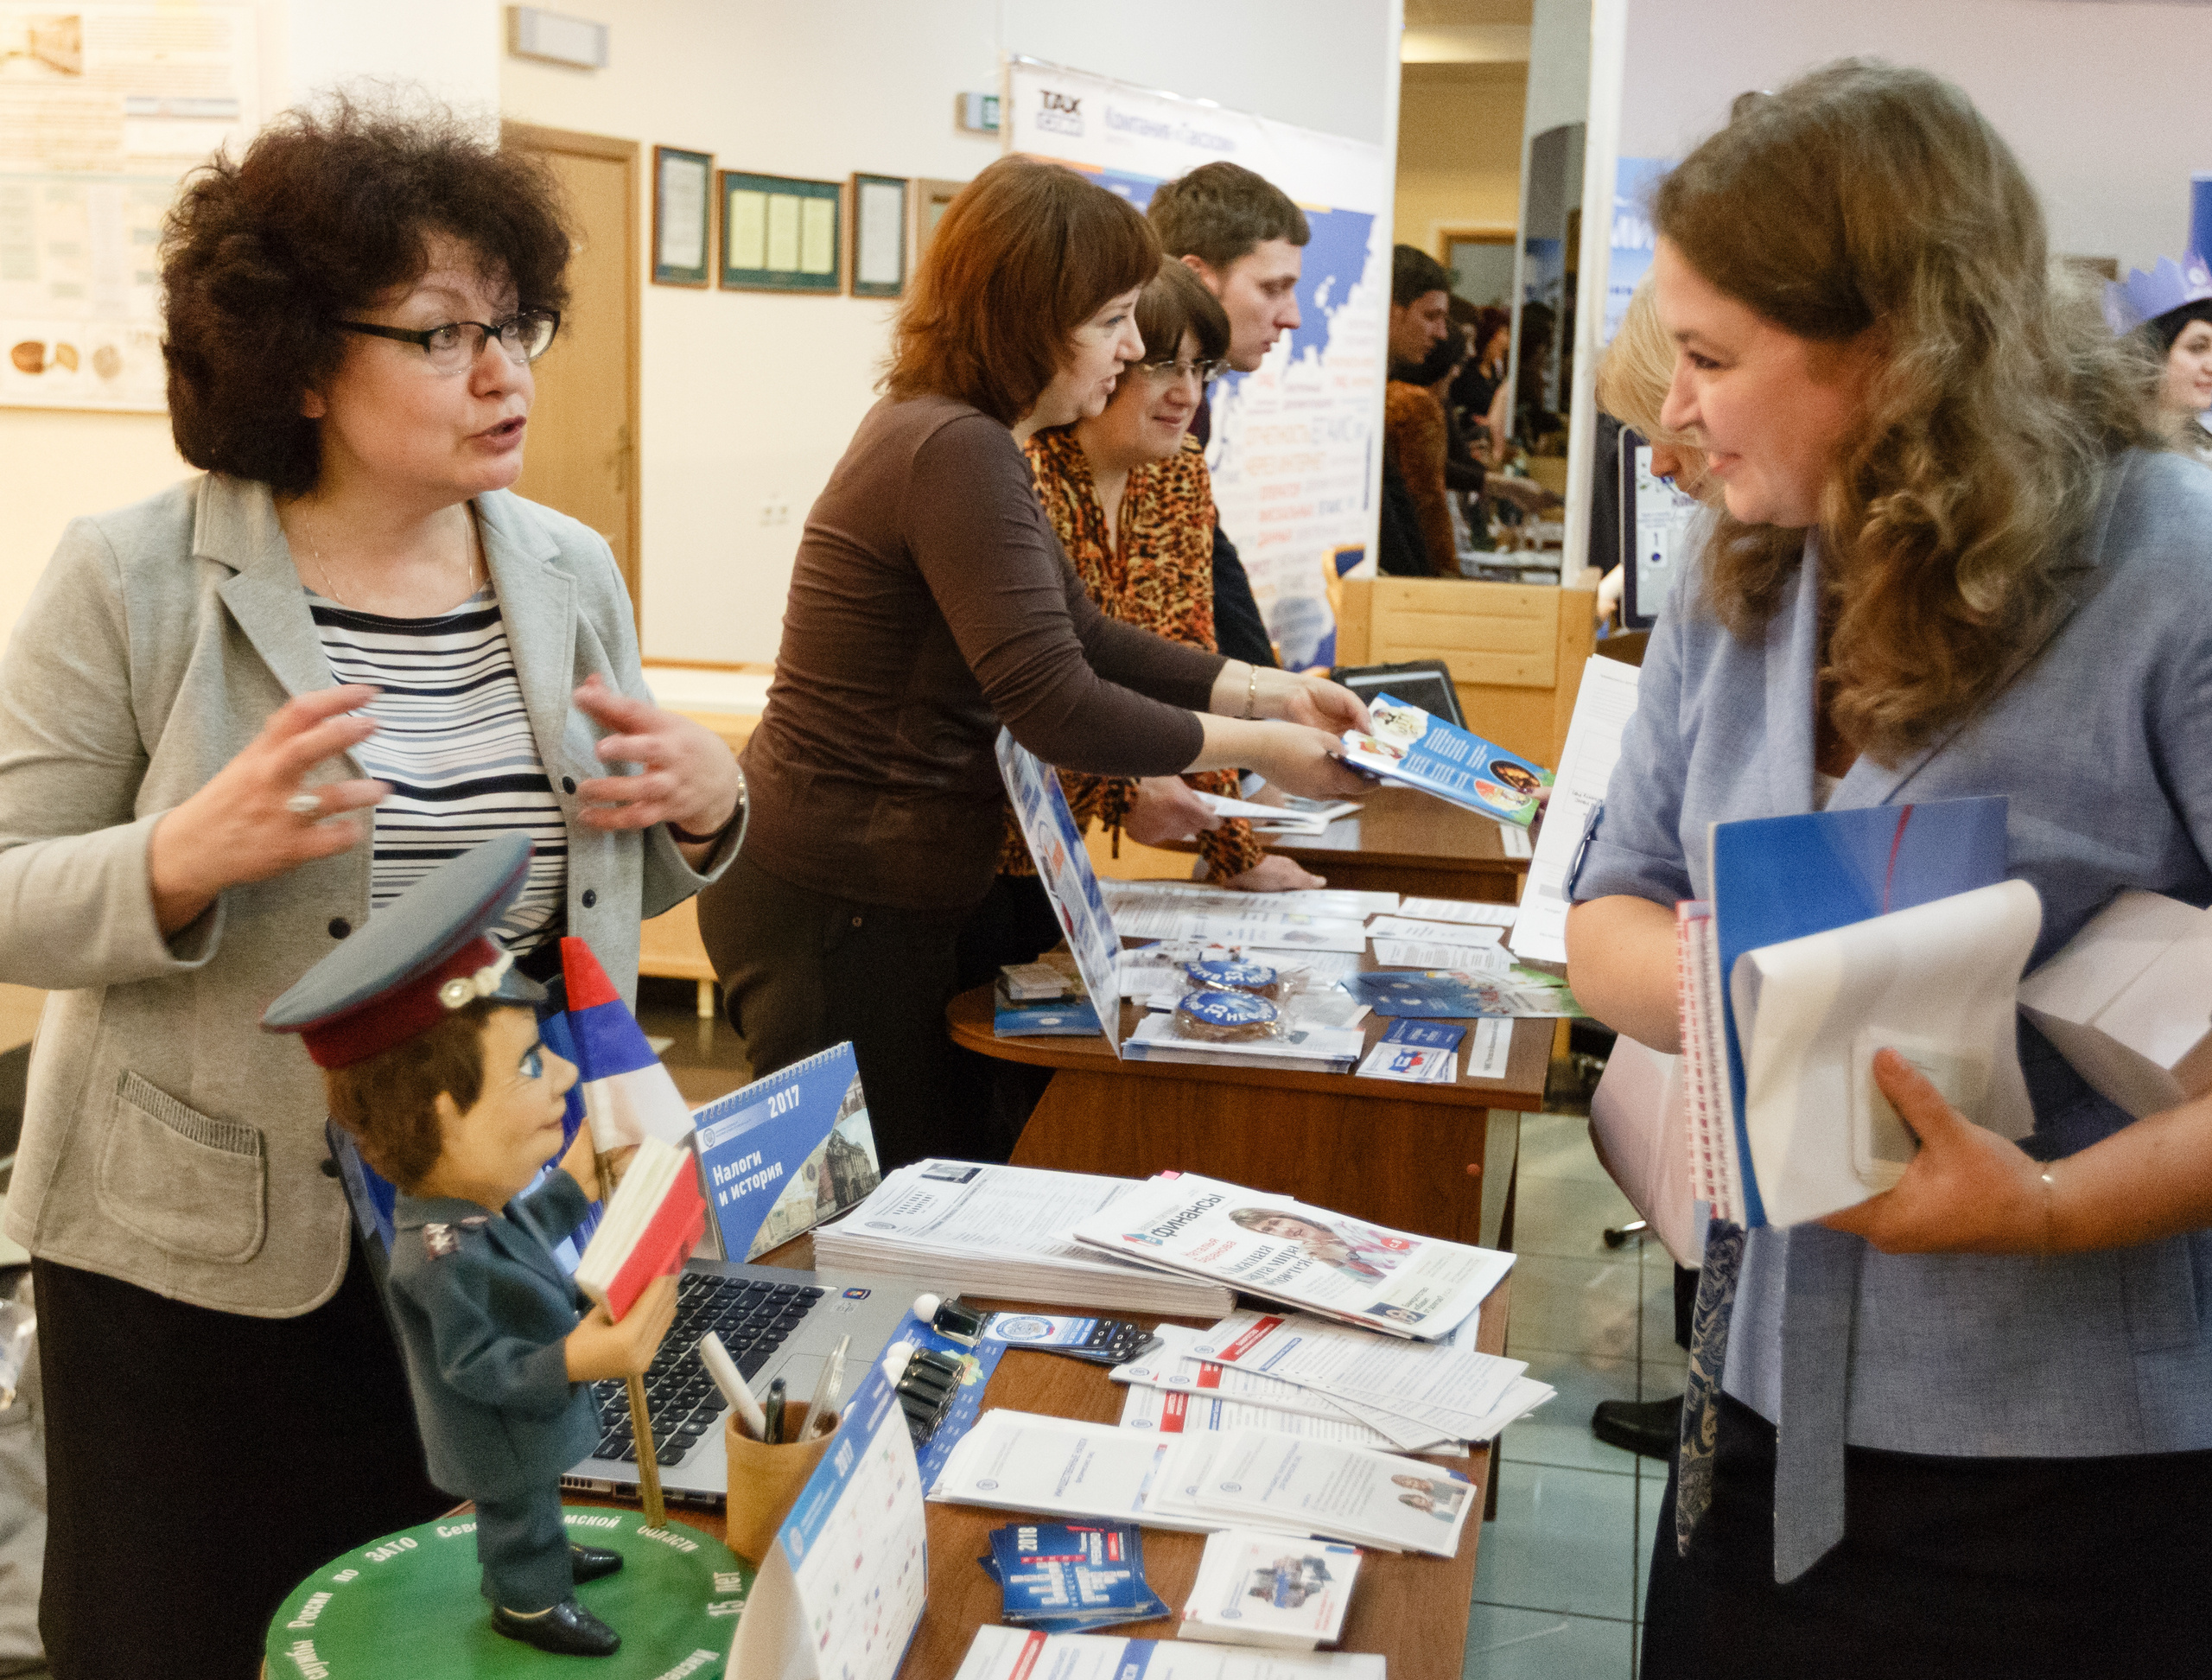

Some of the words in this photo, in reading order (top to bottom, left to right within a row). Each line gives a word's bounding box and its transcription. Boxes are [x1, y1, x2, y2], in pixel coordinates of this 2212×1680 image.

[1040, 89, 1081, 115] TAX
[767, 1084, 799, 1118] 2017
[712, 1150, 762, 1187] Налоги
[718, 1190, 728, 1206] и
[730, 1161, 784, 1200] история
[1150, 1193, 1226, 1238] финансы
[1183, 1238, 1220, 1259] Наталья
[1192, 1240, 1237, 1264] Баранова
[286, 1591, 334, 1629] России
[332, 1569, 359, 1582] по
[365, 1537, 419, 1562] ЗАТО
[435, 1521, 477, 1538] Сев
[563, 1514, 623, 1529] мской
[707, 1600, 746, 1617] 15
